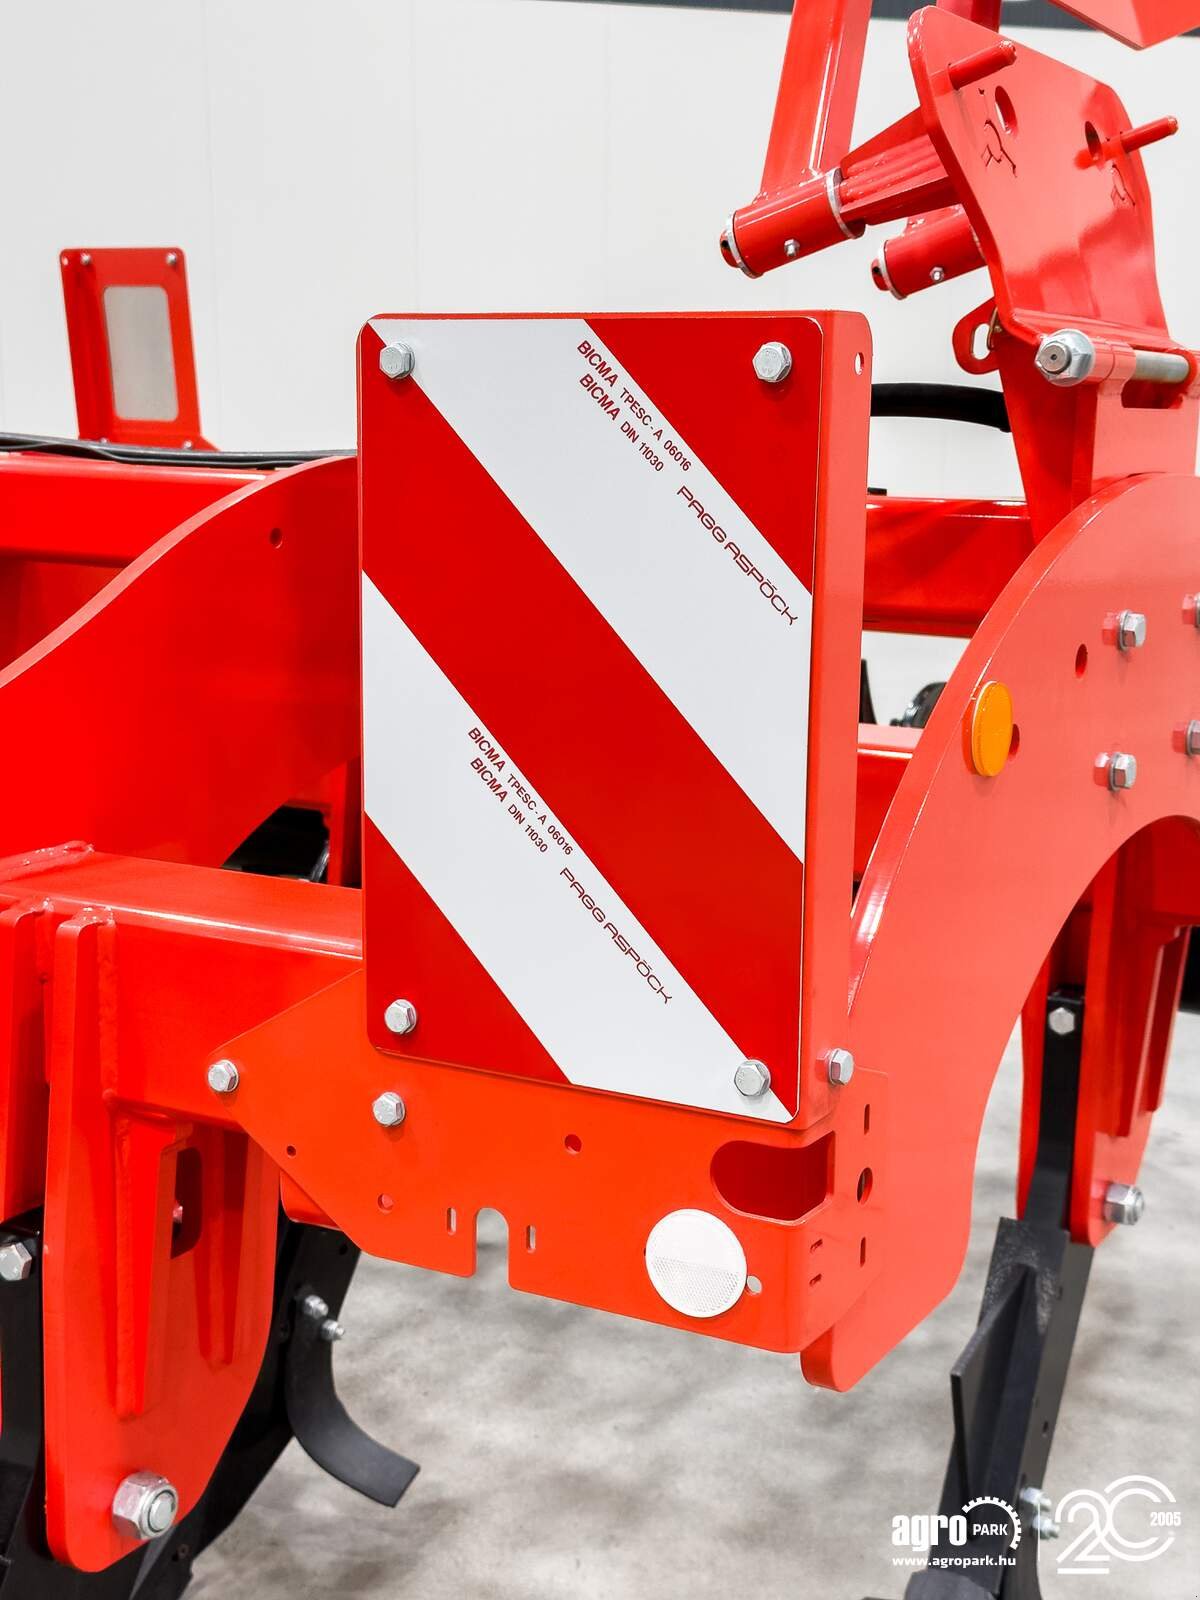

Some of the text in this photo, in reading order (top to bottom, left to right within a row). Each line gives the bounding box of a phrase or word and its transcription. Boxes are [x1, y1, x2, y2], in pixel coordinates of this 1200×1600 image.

[577, 340, 618, 387] BICMA
[663, 440, 691, 472] 06016
[580, 374, 664, 472] BICMA DIN 11030
[468, 727, 506, 772] BICMA
[547, 825, 573, 855] 06016
[470, 757, 548, 853] BICMA DIN 11030
